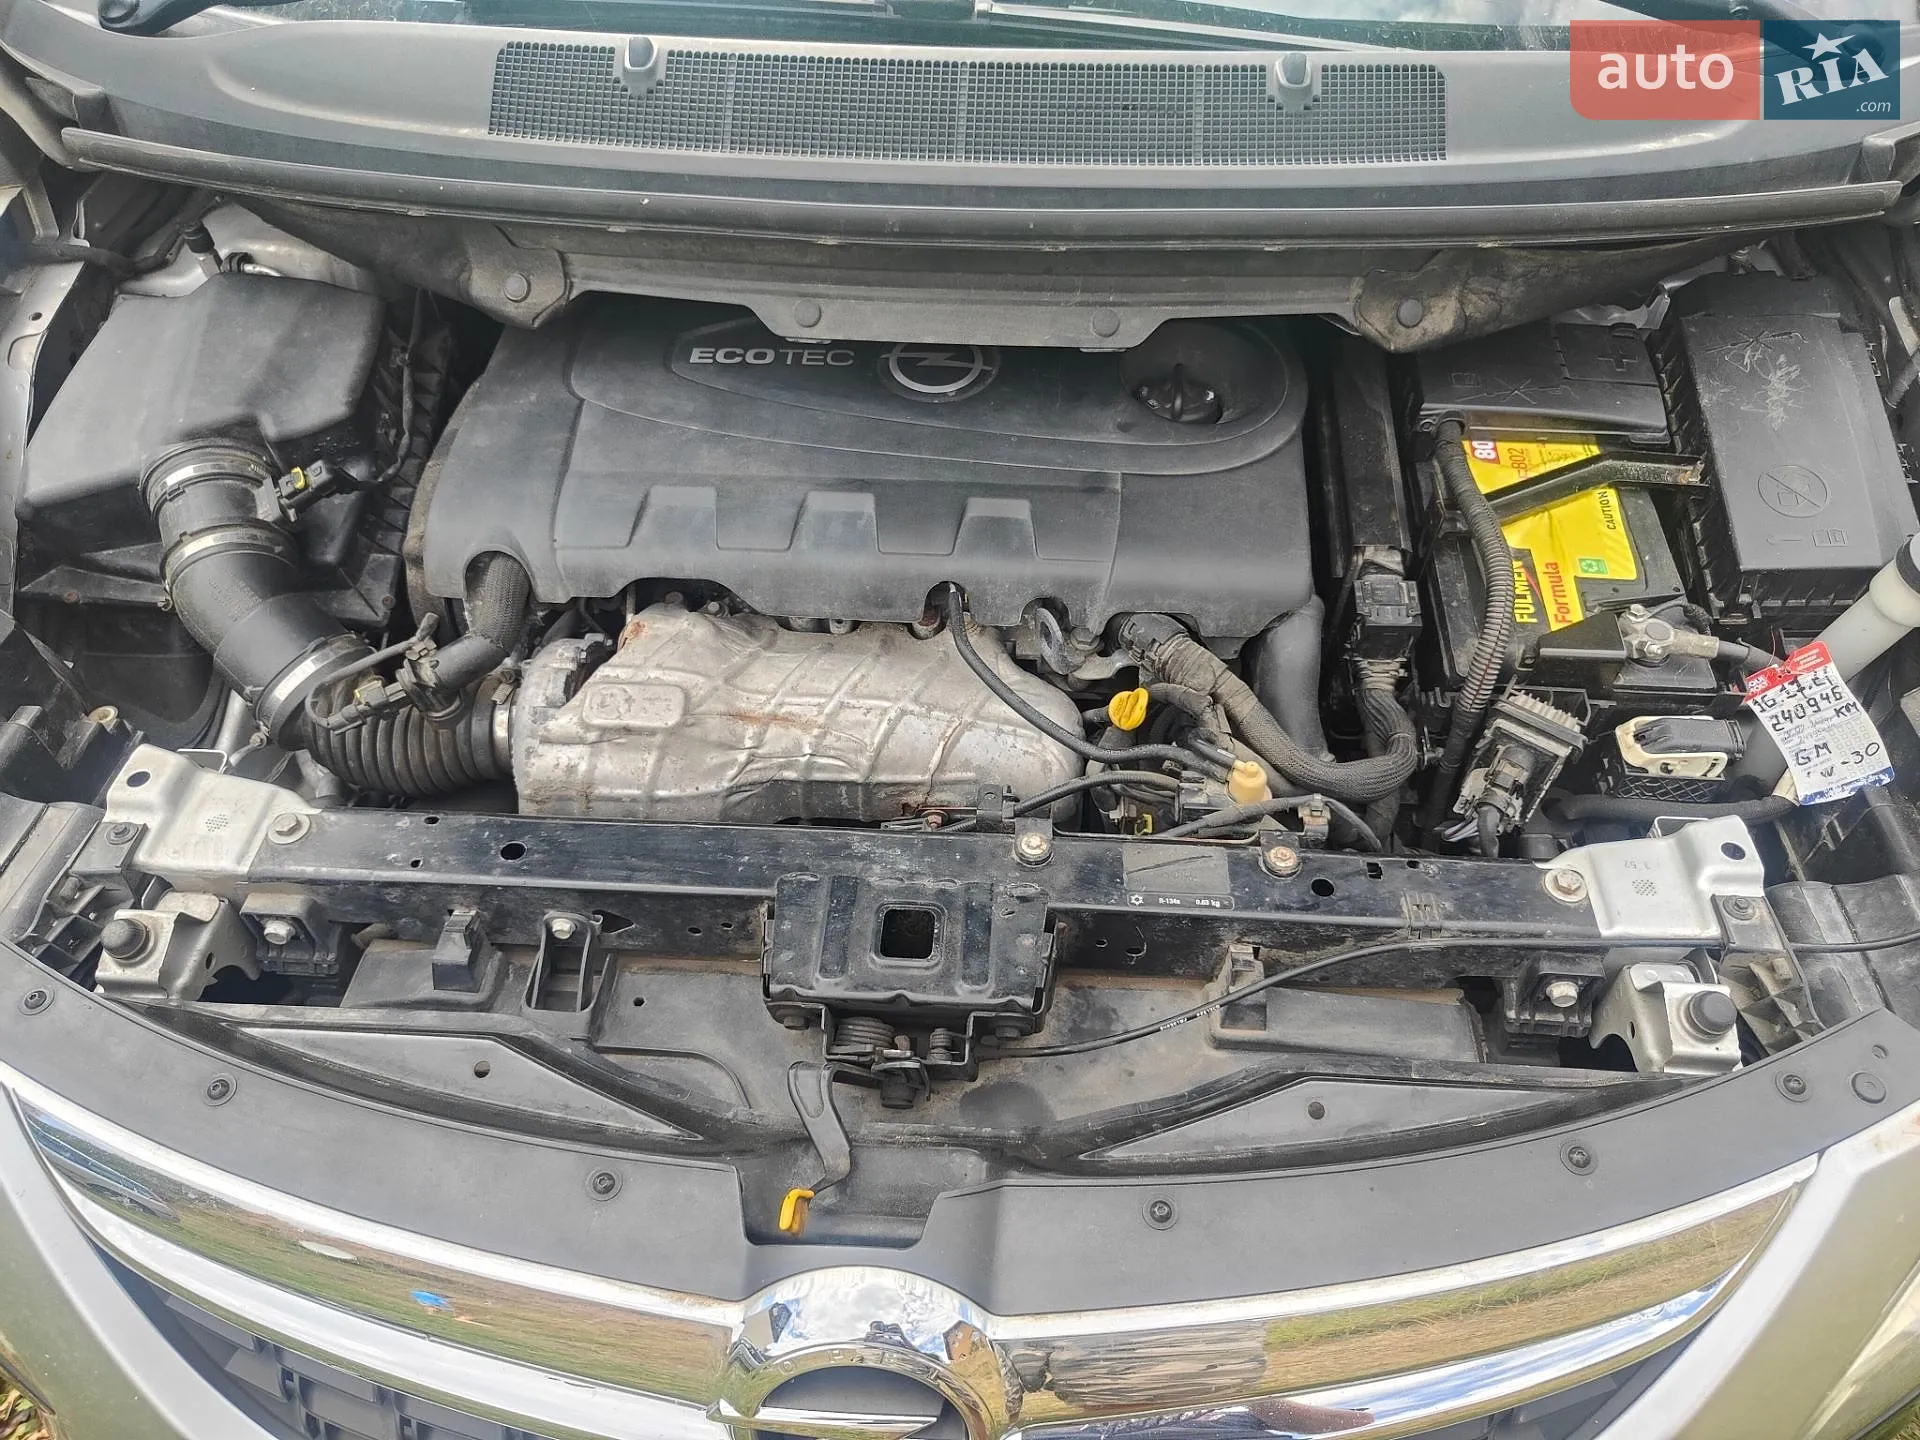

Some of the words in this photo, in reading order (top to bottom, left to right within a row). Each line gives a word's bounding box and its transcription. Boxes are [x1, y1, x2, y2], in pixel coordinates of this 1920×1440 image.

[689, 347, 855, 366] ECOTEC
[1597, 491, 1616, 530] CAUTION
[1543, 562, 1573, 624] Formula
